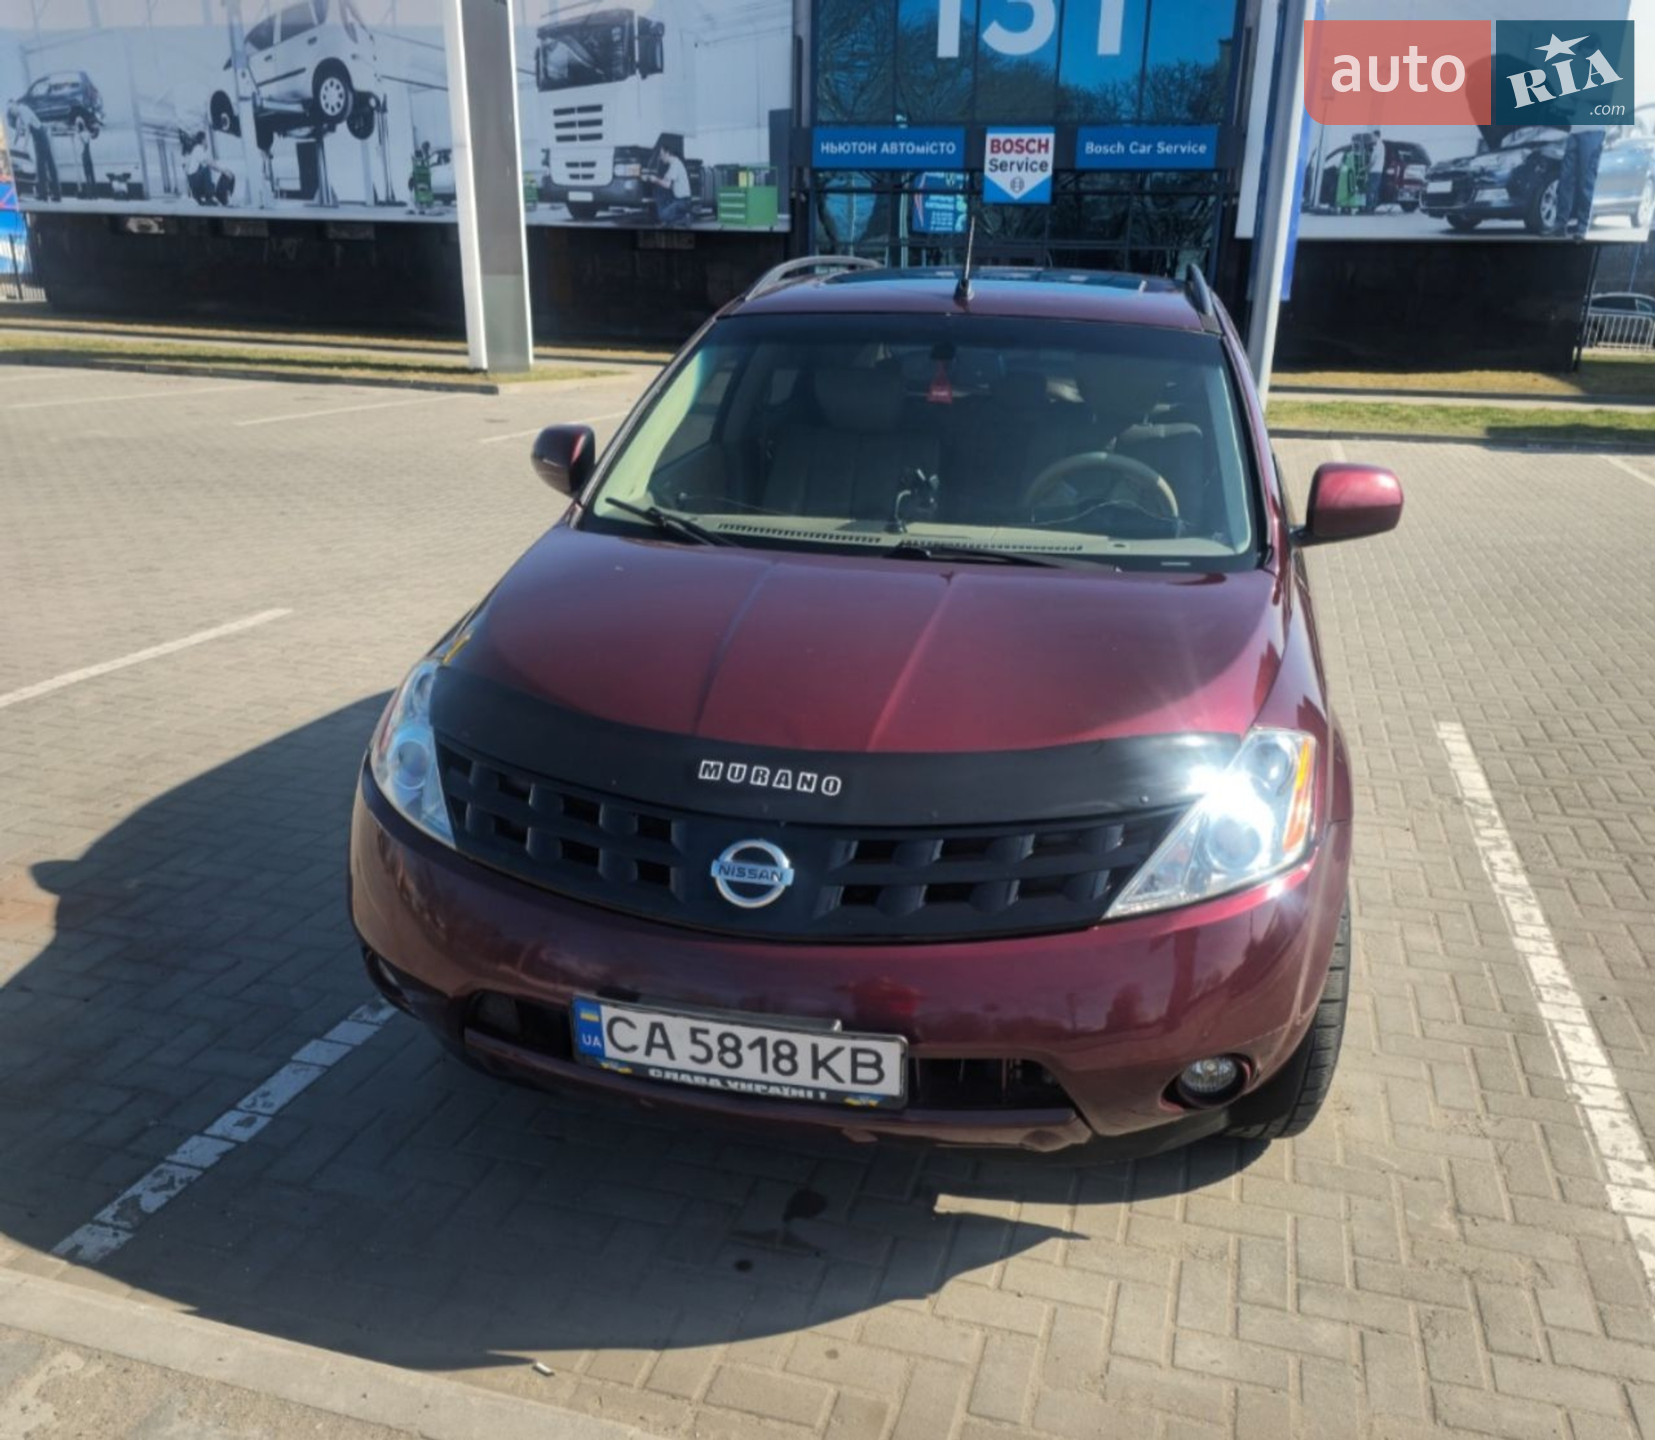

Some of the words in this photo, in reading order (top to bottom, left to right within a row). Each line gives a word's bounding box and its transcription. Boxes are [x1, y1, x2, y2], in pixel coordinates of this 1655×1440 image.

[820, 141, 877, 155] НЬЮТОН
[990, 138, 1050, 155] BOSCH
[1084, 140, 1125, 155] Bosch
[1128, 140, 1153, 155] Car
[1156, 140, 1208, 155] Service
[988, 156, 1049, 173] Service
[698, 759, 842, 796] MURANO
[718, 864, 784, 883] NISSAN
[581, 1033, 602, 1049] UA
[606, 1016, 676, 1061] CA
[689, 1026, 799, 1077] 5818
[810, 1042, 886, 1087] KB
